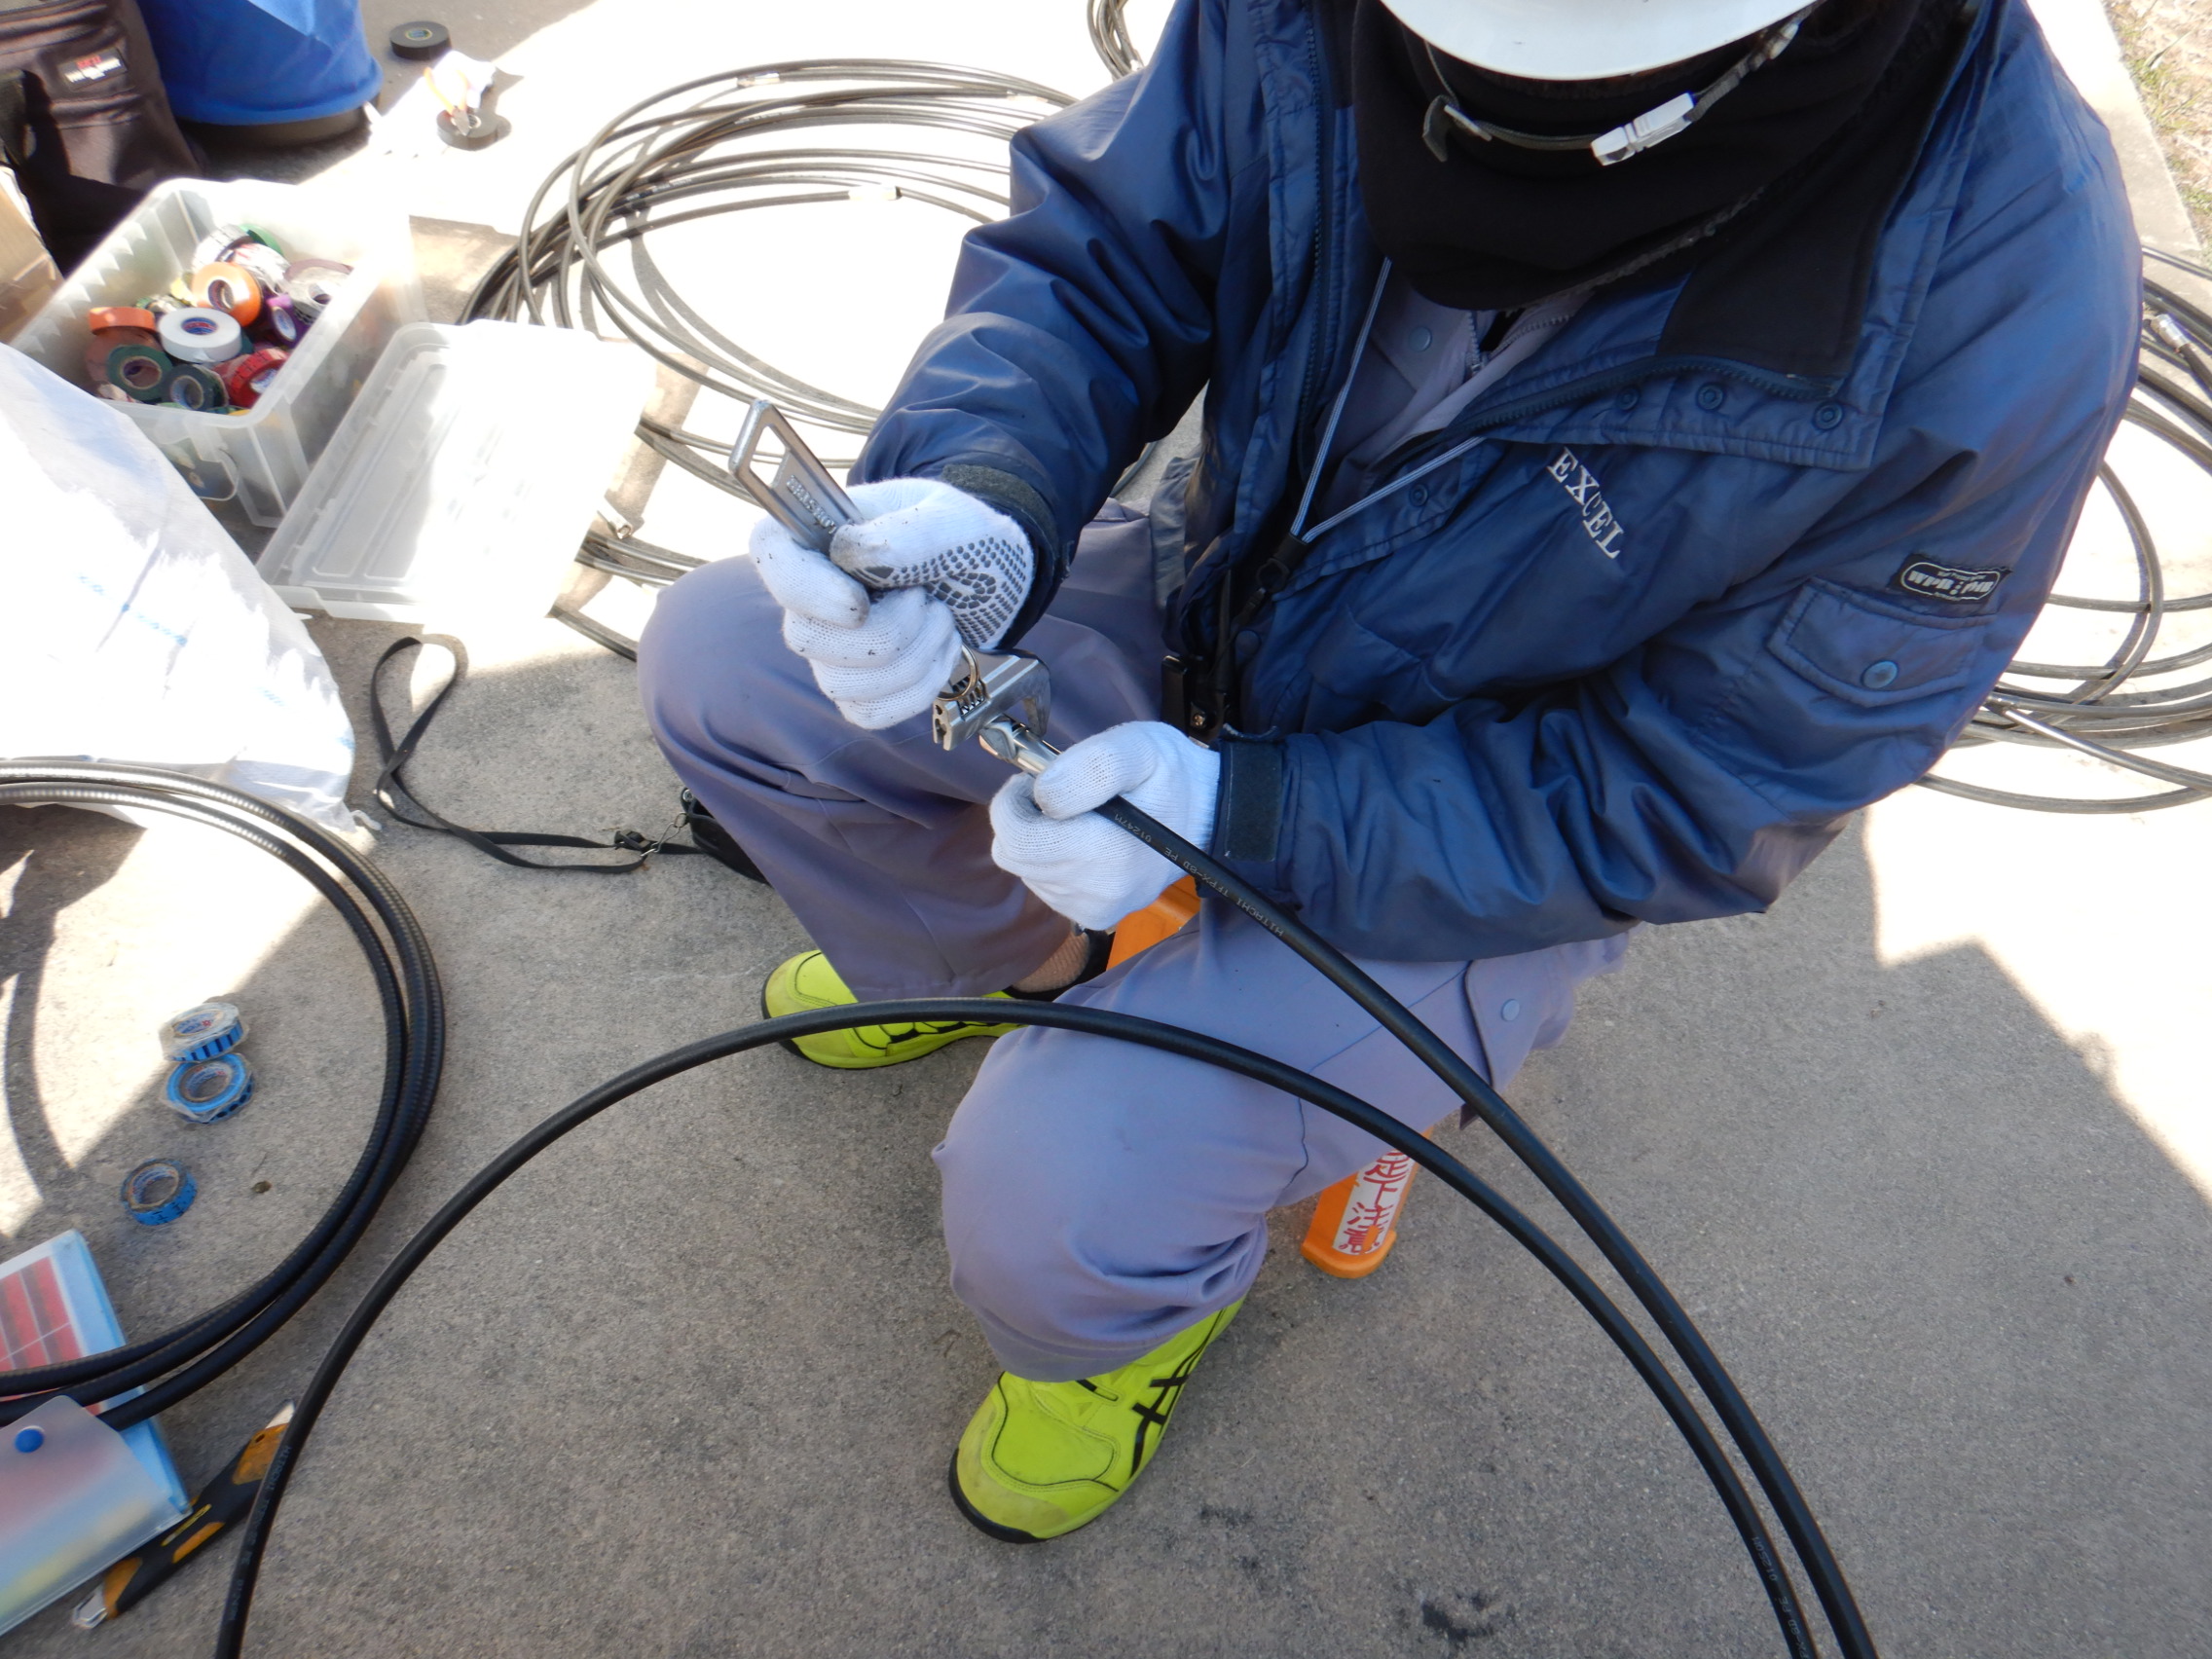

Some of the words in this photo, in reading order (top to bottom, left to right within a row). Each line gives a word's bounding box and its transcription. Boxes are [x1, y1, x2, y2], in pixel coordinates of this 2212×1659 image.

[1547, 446, 1624, 559] EXCEL
[1163, 846, 1179, 862] PE
[1235, 897, 1285, 937] HITACHI
[1777, 1595, 1792, 1614] PE
